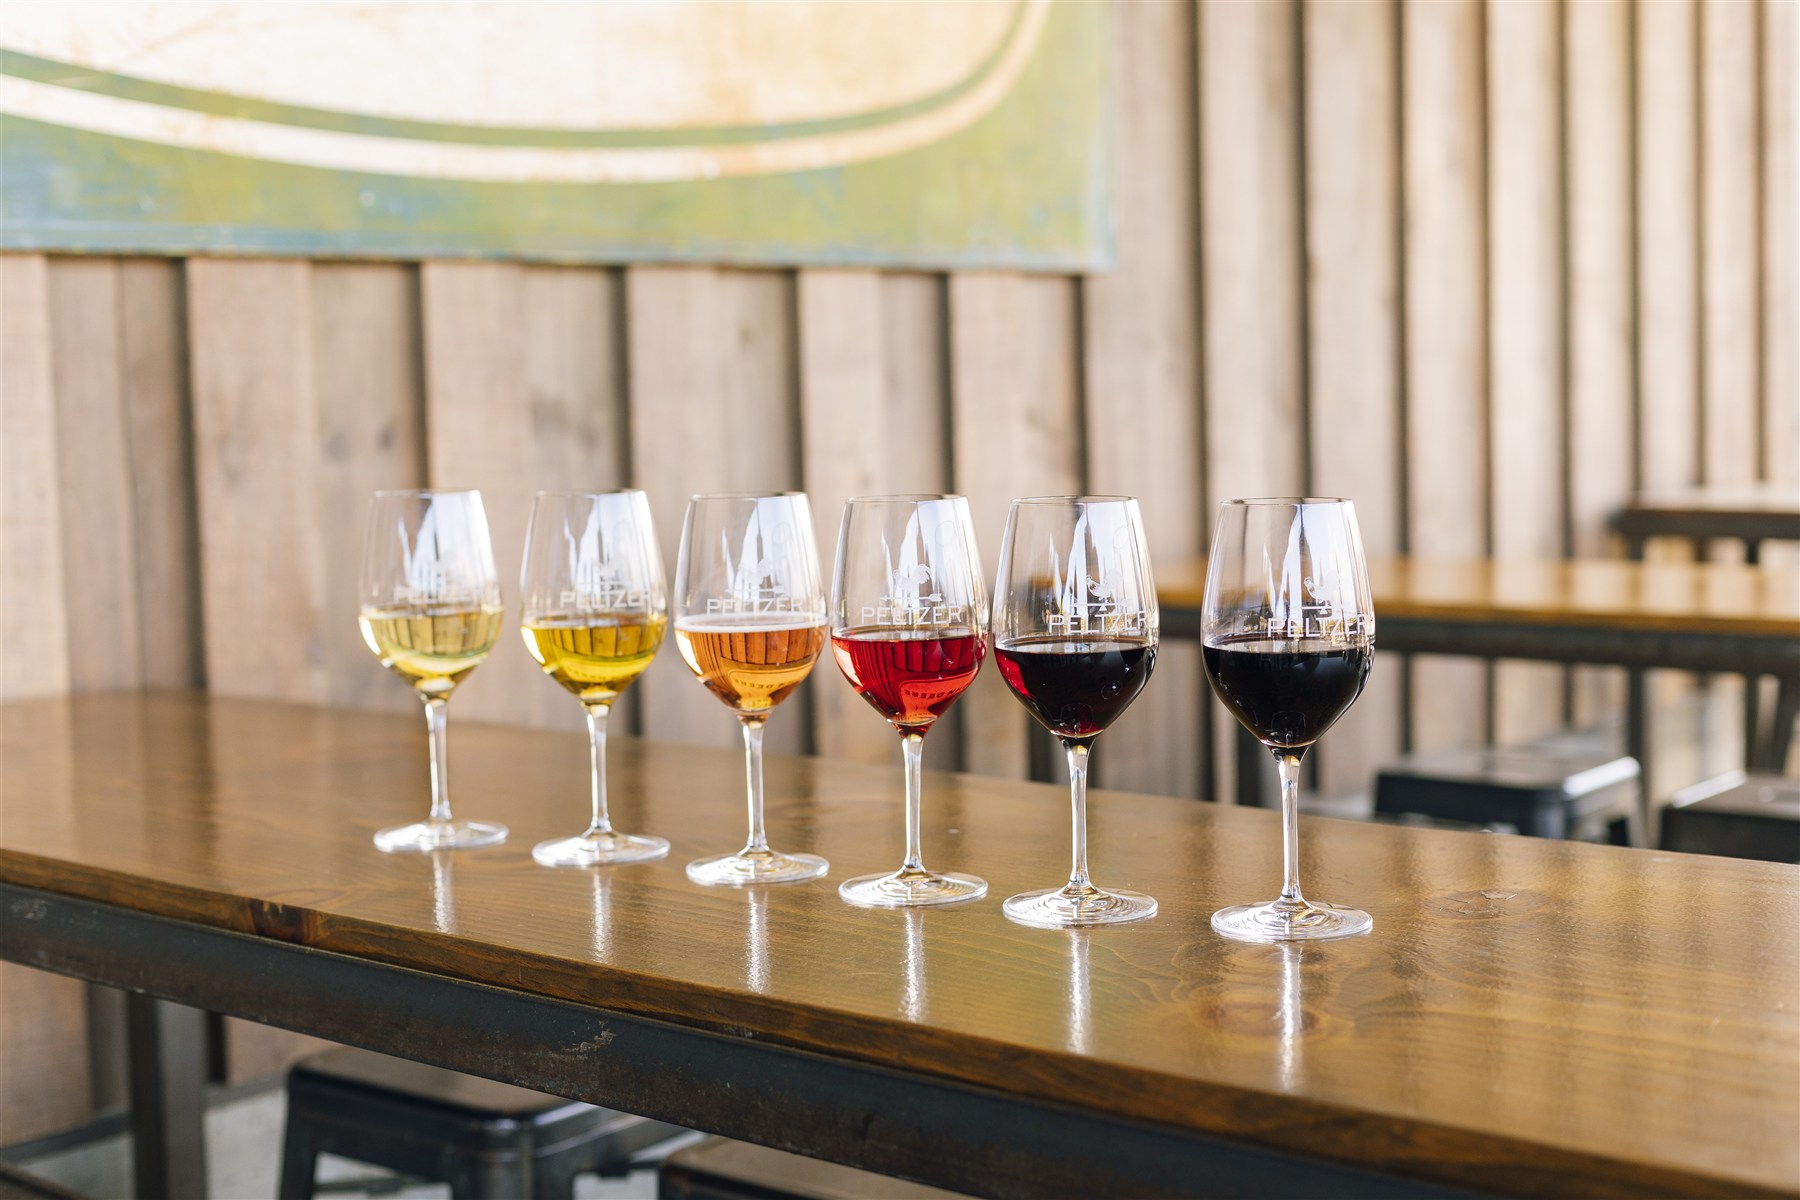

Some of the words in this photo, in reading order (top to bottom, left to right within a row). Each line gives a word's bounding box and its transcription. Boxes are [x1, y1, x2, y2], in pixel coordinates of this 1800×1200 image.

[861, 605, 962, 625] PELTZER
[1049, 610, 1149, 634] PELTZER
[1267, 613, 1368, 638] PELTZER
